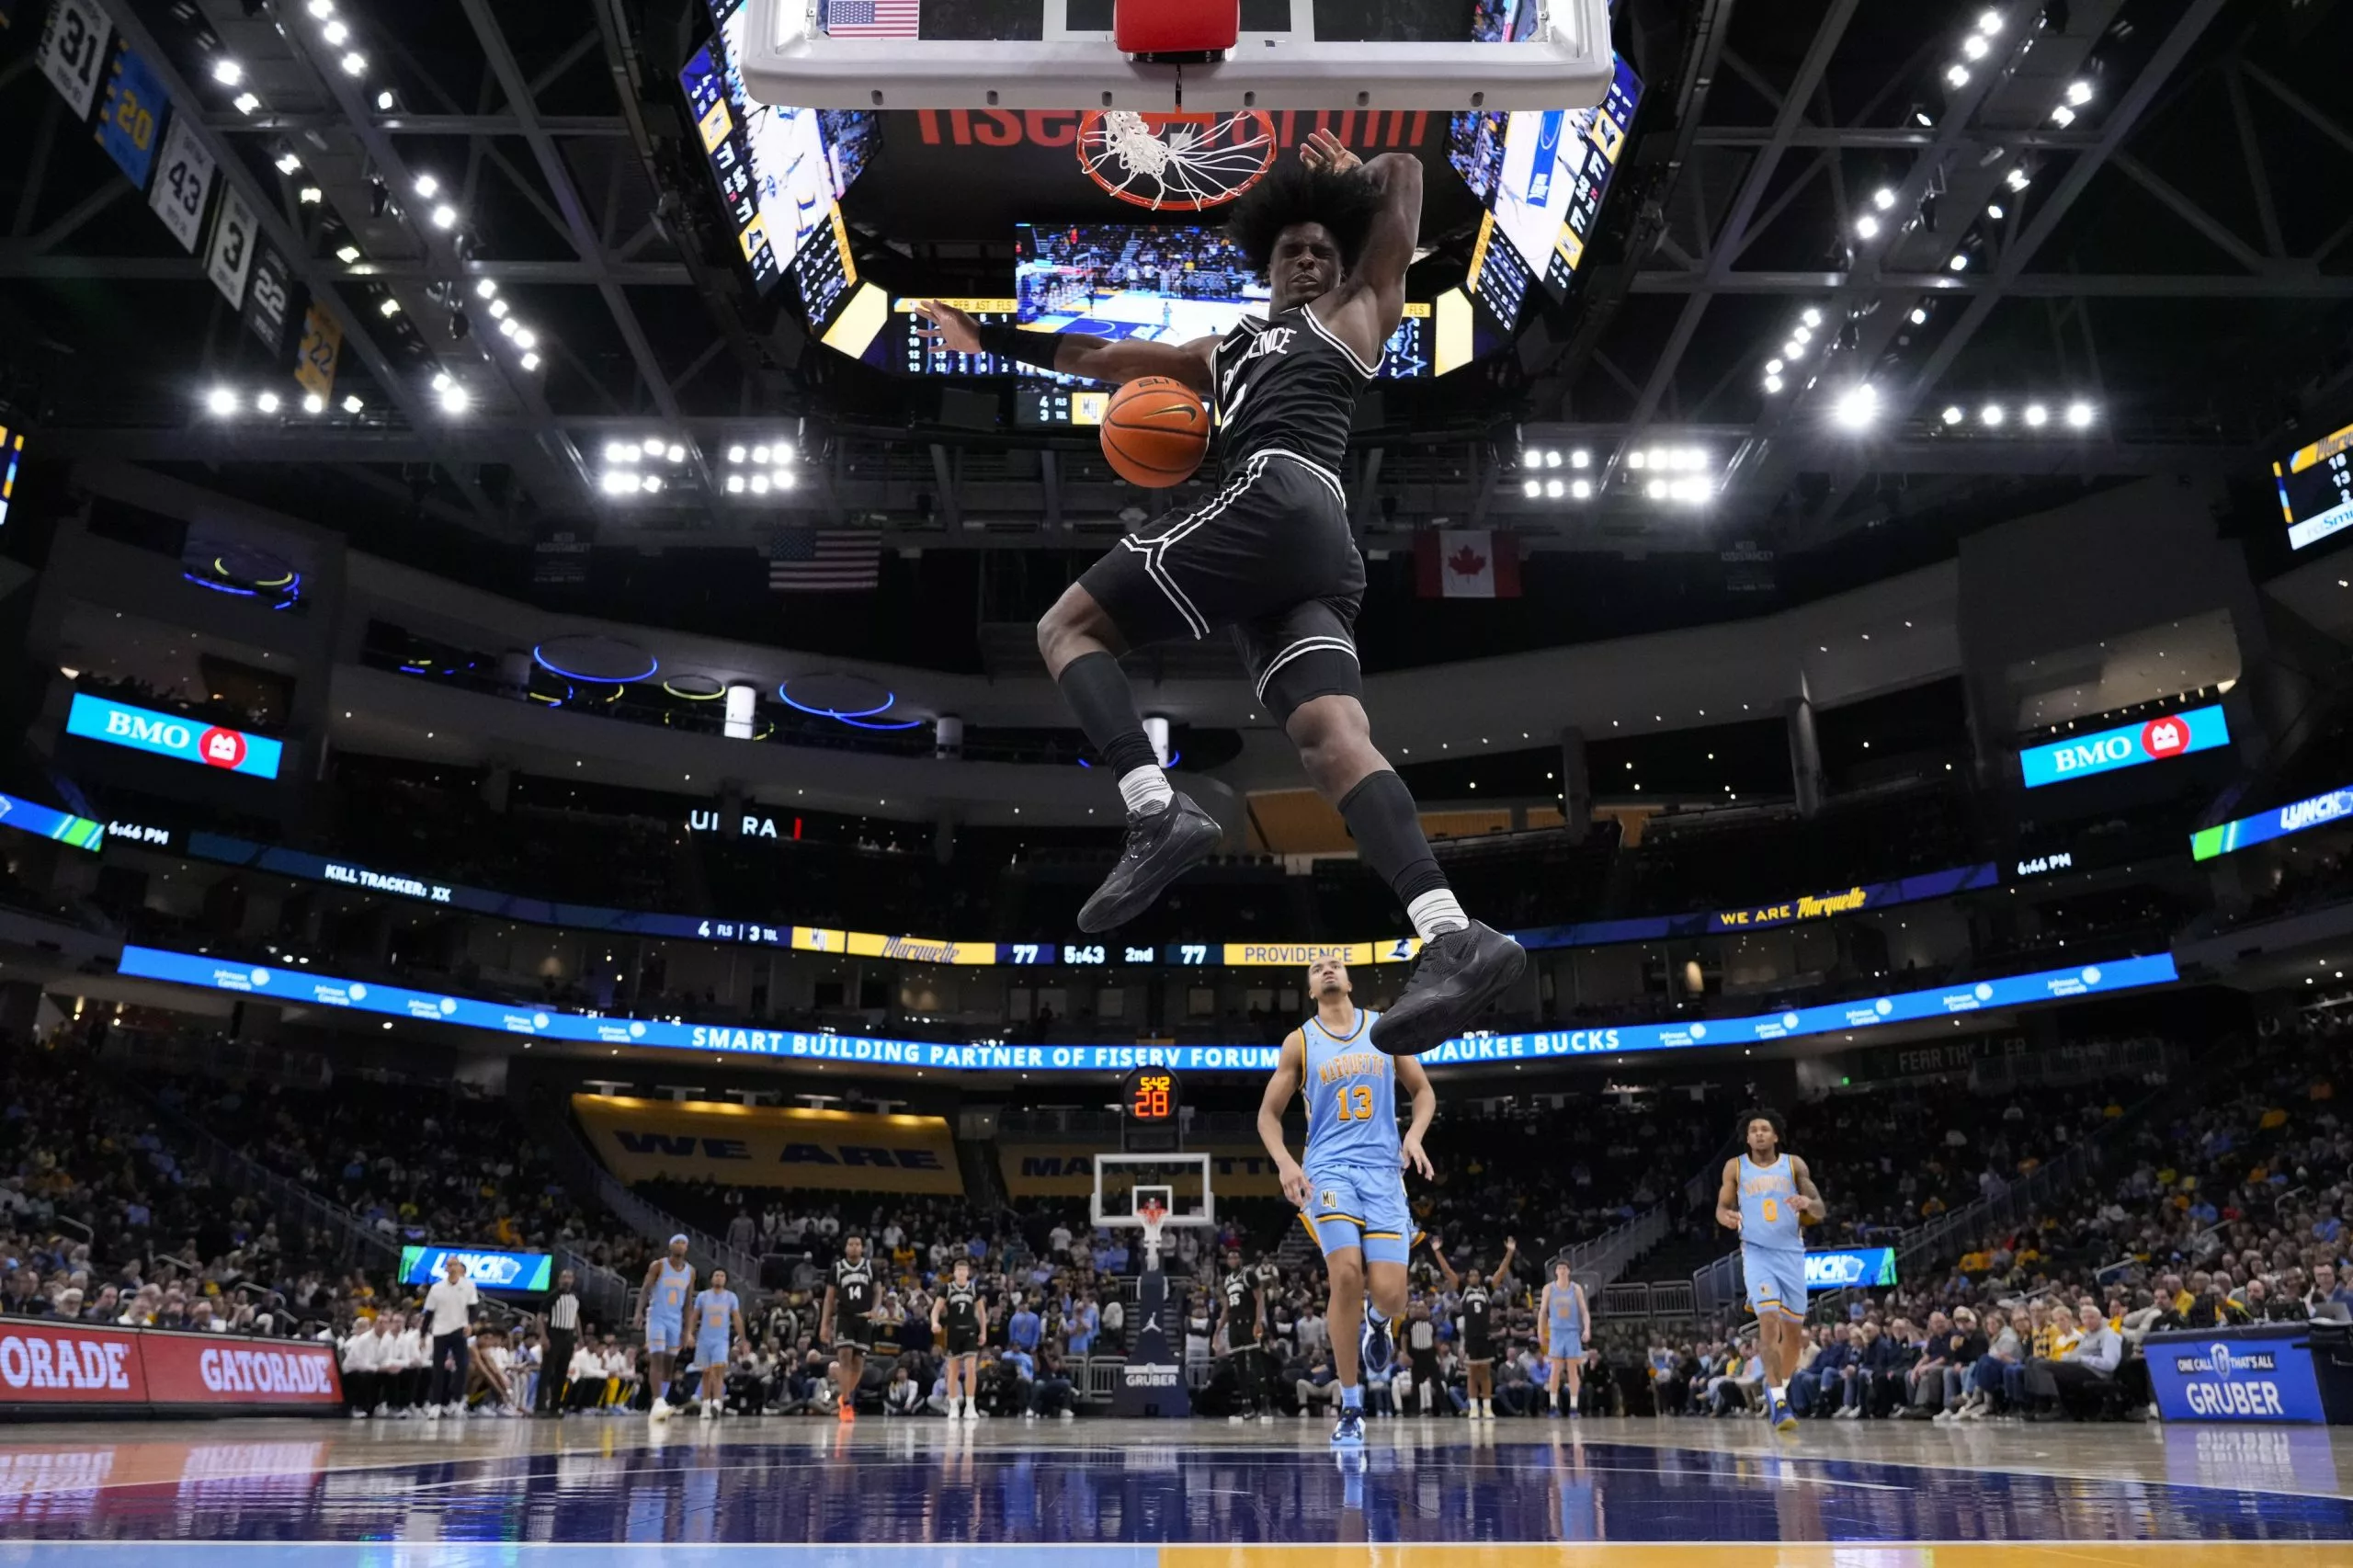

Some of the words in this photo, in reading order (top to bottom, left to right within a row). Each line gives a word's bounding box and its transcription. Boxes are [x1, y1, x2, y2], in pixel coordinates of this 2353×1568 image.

[59, 7, 97, 86] 31
[117, 89, 153, 151] 20
[717, 142, 735, 168] 77
[1588, 151, 1605, 180] 77
[169, 161, 201, 216] 43
[736, 198, 753, 222] 77
[1570, 206, 1586, 233] 77
[223, 222, 244, 273] 3
[254, 267, 286, 324] 22
[975, 301, 990, 311] AST
[997, 301, 1012, 311] FLS
[1409, 305, 1424, 314] FLS
[908, 350, 920, 359] 12
[908, 363, 920, 372] 13
[935, 363, 947, 372] 12
[959, 363, 965, 372] 3
[1002, 363, 1008, 372] 2
[1040, 396, 1049, 407] 4
[1040, 410, 1049, 421] 3
[2328, 453, 2347, 470] 10
[2333, 471, 2351, 487] 13
[106, 710, 190, 749] BMO
[2053, 736, 2132, 773] BMO
[143, 828, 169, 845] PM
[2049, 853, 2072, 869] PM
[324, 864, 358, 884] KILL
[359, 871, 426, 897] TRACKER:
[431, 886, 451, 903] XX
[1722, 912, 1749, 926] WE
[1756, 905, 1790, 923] ARE
[1797, 887, 1866, 918] Marquette
[698, 921, 710, 937] 4
[717, 924, 733, 937] FLS
[749, 926, 760, 941] 3
[763, 928, 778, 941] TOL
[881, 936, 960, 963] Marquette
[1013, 945, 1039, 963] 77
[1064, 946, 1105, 964] 5:43
[1125, 947, 1154, 962] 2nd
[1180, 945, 1207, 964] 77
[1245, 947, 1353, 963] PROVIDENCE
[2048, 977, 2079, 990] Johnson
[2053, 983, 2087, 996] Controls
[1943, 994, 1972, 1006] Johnson
[1949, 1000, 1980, 1012] Controls
[692, 1027, 784, 1052] SMART
[793, 1034, 919, 1062] BUILDING
[930, 1045, 1043, 1066] PARTNER
[1053, 1049, 1085, 1067] OF
[1095, 1049, 1179, 1067] FISERV
[1194, 1048, 1280, 1067] FORUM
[1534, 1030, 1620, 1054] BUCKS
[1897, 1051, 1940, 1072] FEAR
[1141, 1077, 1170, 1092] 5:42
[1135, 1091, 1168, 1117] 28
[1337, 1085, 1373, 1121] 13
[615, 1131, 752, 1160] WE
[779, 1143, 944, 1170] ARE
[1322, 1191, 1336, 1209] MU
[1762, 1198, 1777, 1222] 0
[847, 1286, 861, 1301] 14
[957, 1302, 966, 1314] 7
[1472, 1301, 1482, 1313] 5
[201, 1348, 332, 1394] GATORADE
[2177, 1359, 2194, 1371] ONE
[2194, 1358, 2213, 1371] CALL
[2257, 1356, 2273, 1369] ALL
[1126, 1374, 1176, 1387] GRUBER
[2186, 1381, 2284, 1415] GRUBER
